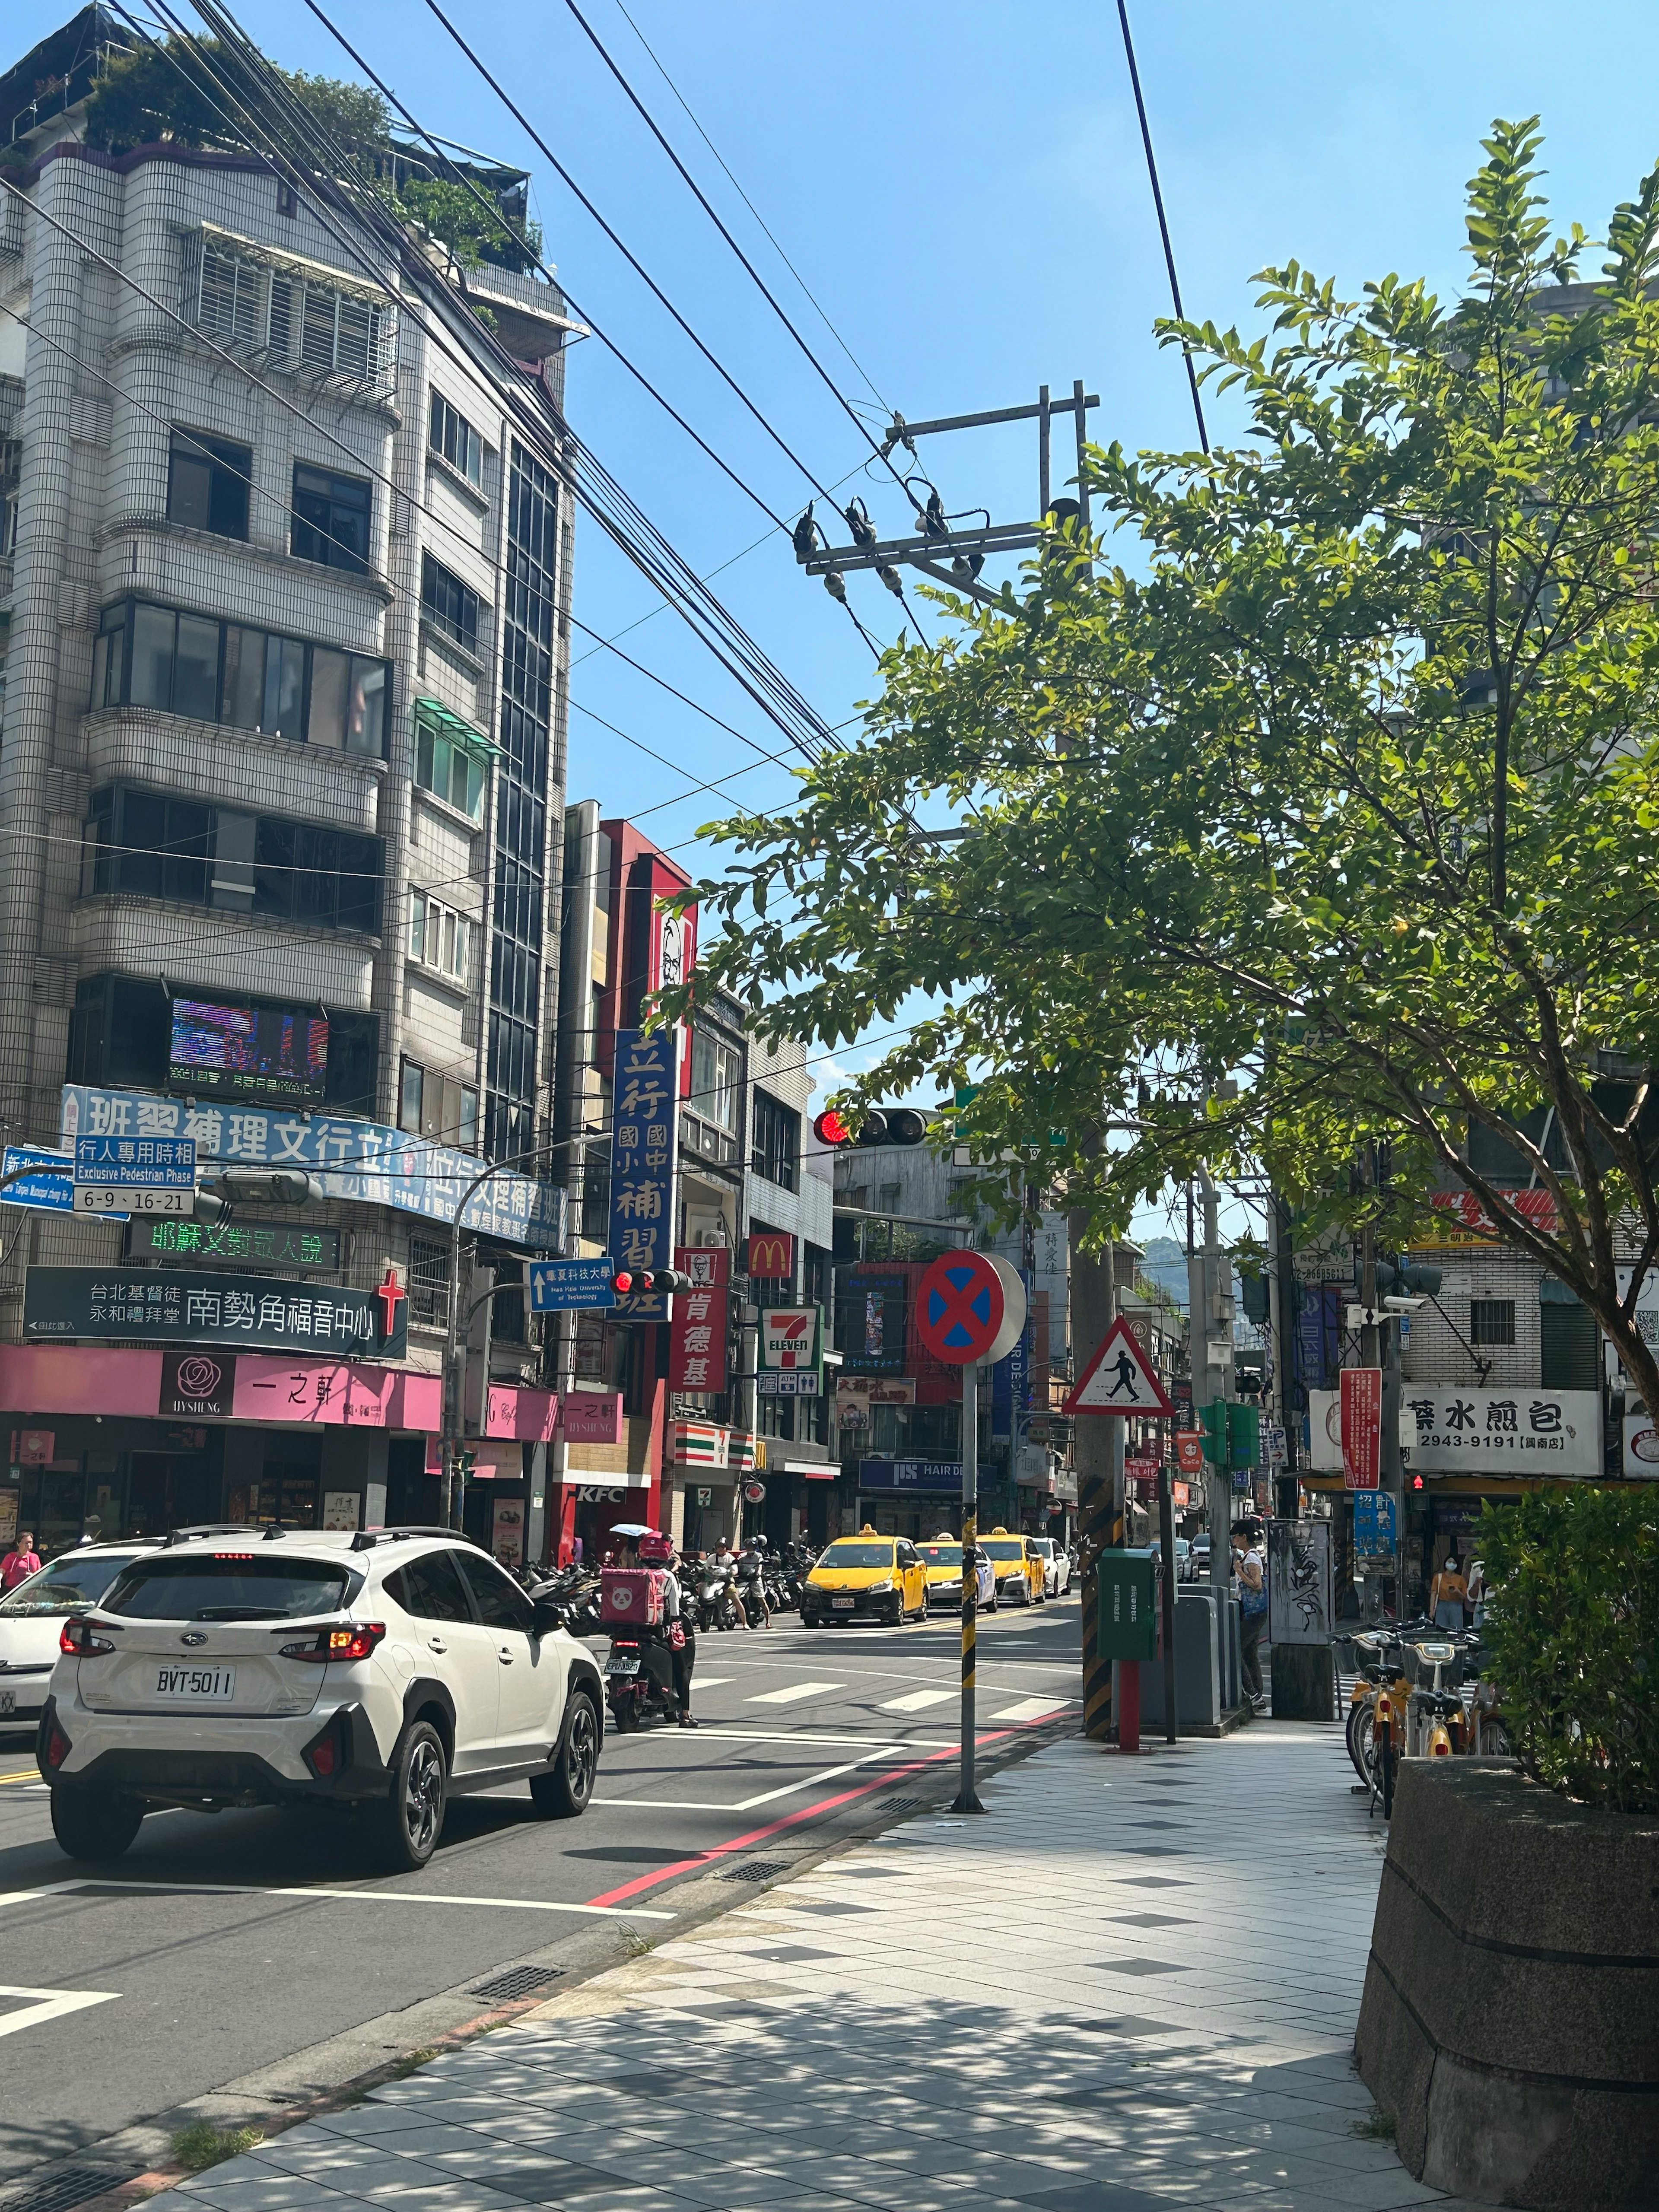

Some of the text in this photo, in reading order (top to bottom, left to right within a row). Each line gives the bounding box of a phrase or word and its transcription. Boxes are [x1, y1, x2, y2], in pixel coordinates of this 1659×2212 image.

[79, 1140, 193, 1165] 行人專用時相
[78, 1165, 118, 1181] Exclusive
[120, 1166, 164, 1182] Pedestrian
[166, 1168, 191, 1183] Phase
[90, 1284, 181, 1303] 台北基督徒
[89, 1304, 180, 1325] 永和禮拜堂
[186, 1287, 374, 1341] 南勢角福音中心
[683, 1293, 712, 1386] 肯德基
[253, 1373, 333, 1405] 一之軒
[567, 1404, 615, 1418] 一之軒
[1406, 1399, 1562, 1433] 蔡水煎包
[1421, 1435, 1515, 1448] 2943-9191
[924, 1465, 951, 1475] HAIR
[576, 1486, 625, 1503] KFC
